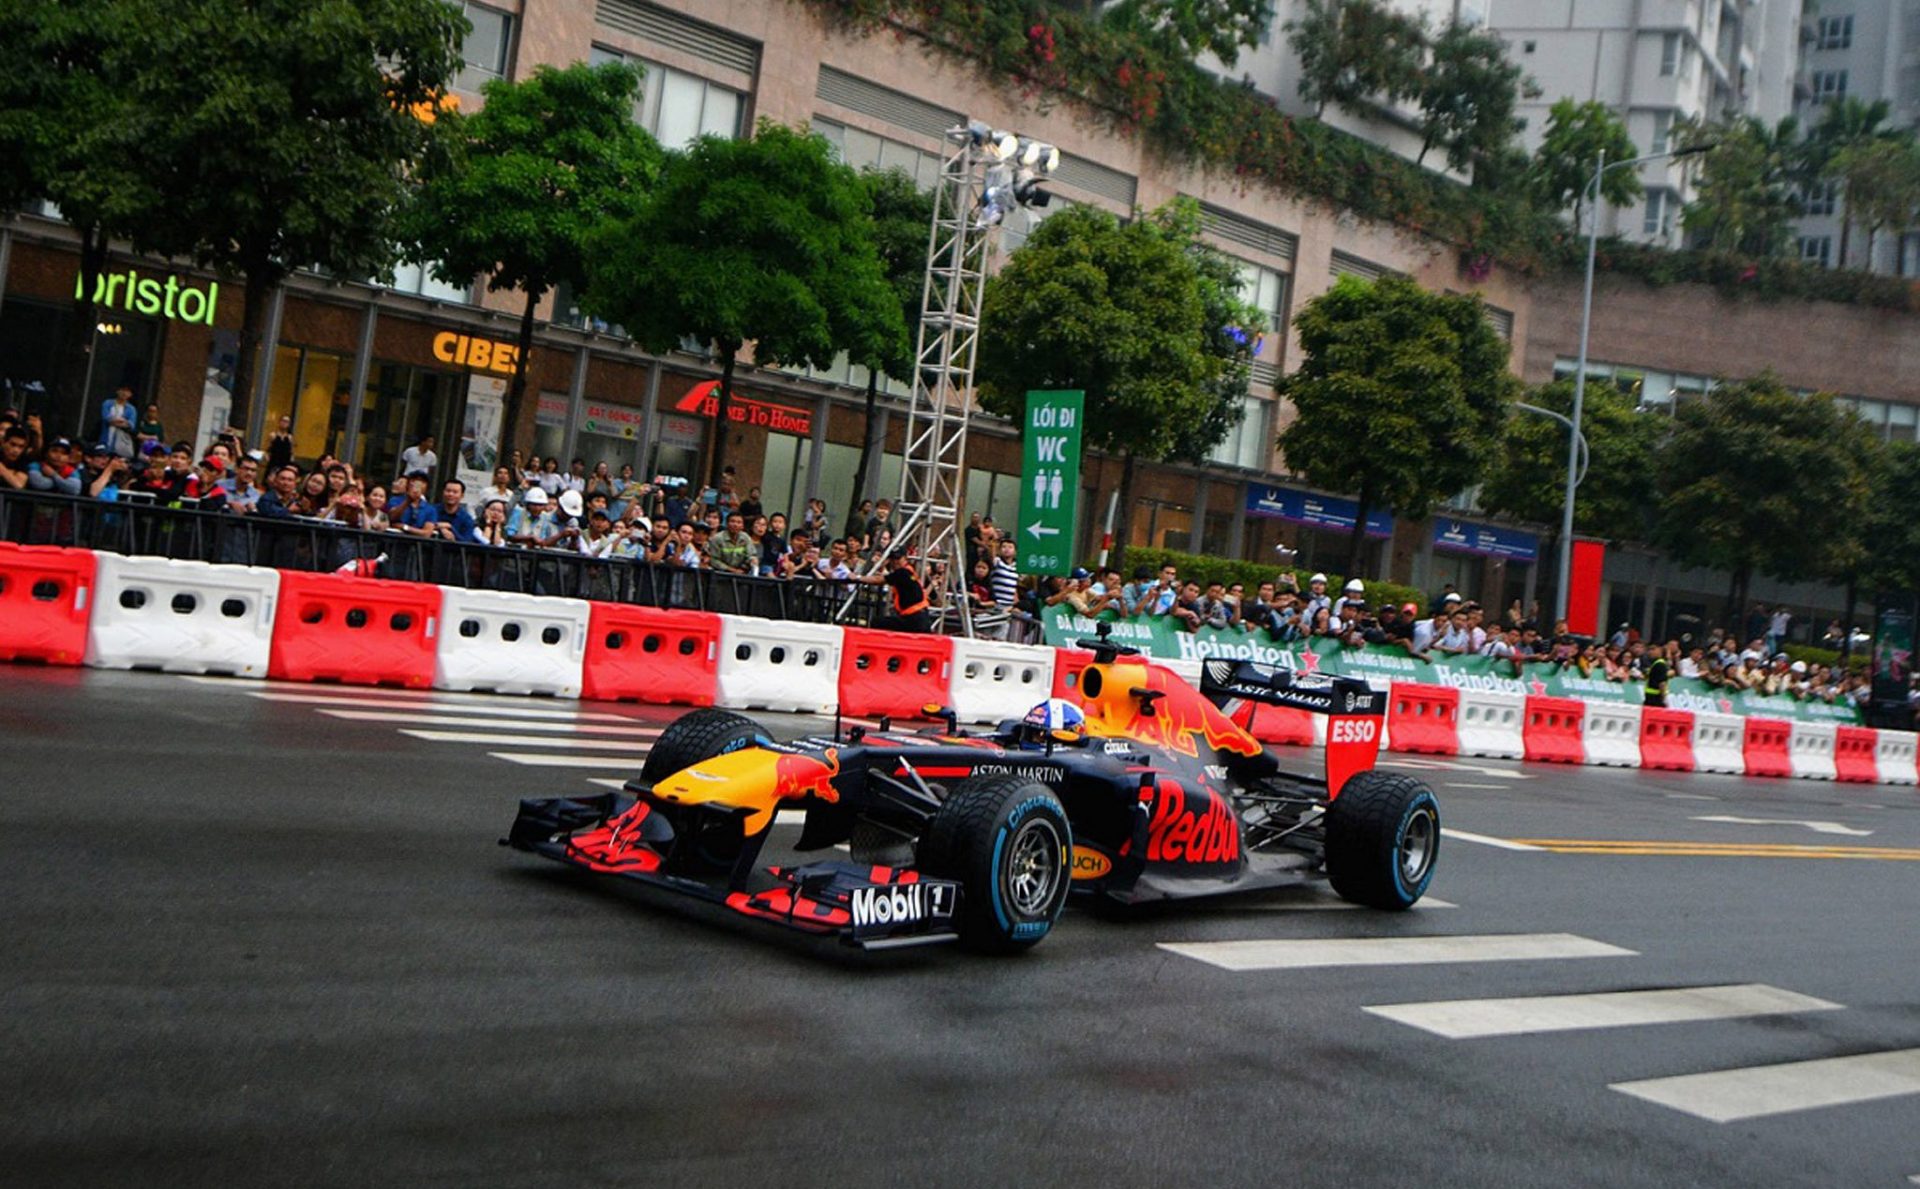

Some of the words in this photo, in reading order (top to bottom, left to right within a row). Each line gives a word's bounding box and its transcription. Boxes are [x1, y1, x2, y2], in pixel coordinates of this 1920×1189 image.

[703, 397, 746, 421] HME
[1037, 436, 1068, 462] WC
[1175, 630, 1297, 673] Heineken
[1434, 663, 1528, 697] Heineken
[1332, 719, 1376, 743] ESSO
[971, 765, 1013, 778] ASTON
[1016, 766, 1064, 782] MARTIN
[1072, 855, 1103, 871] UCH
[852, 884, 921, 927] Mobil
